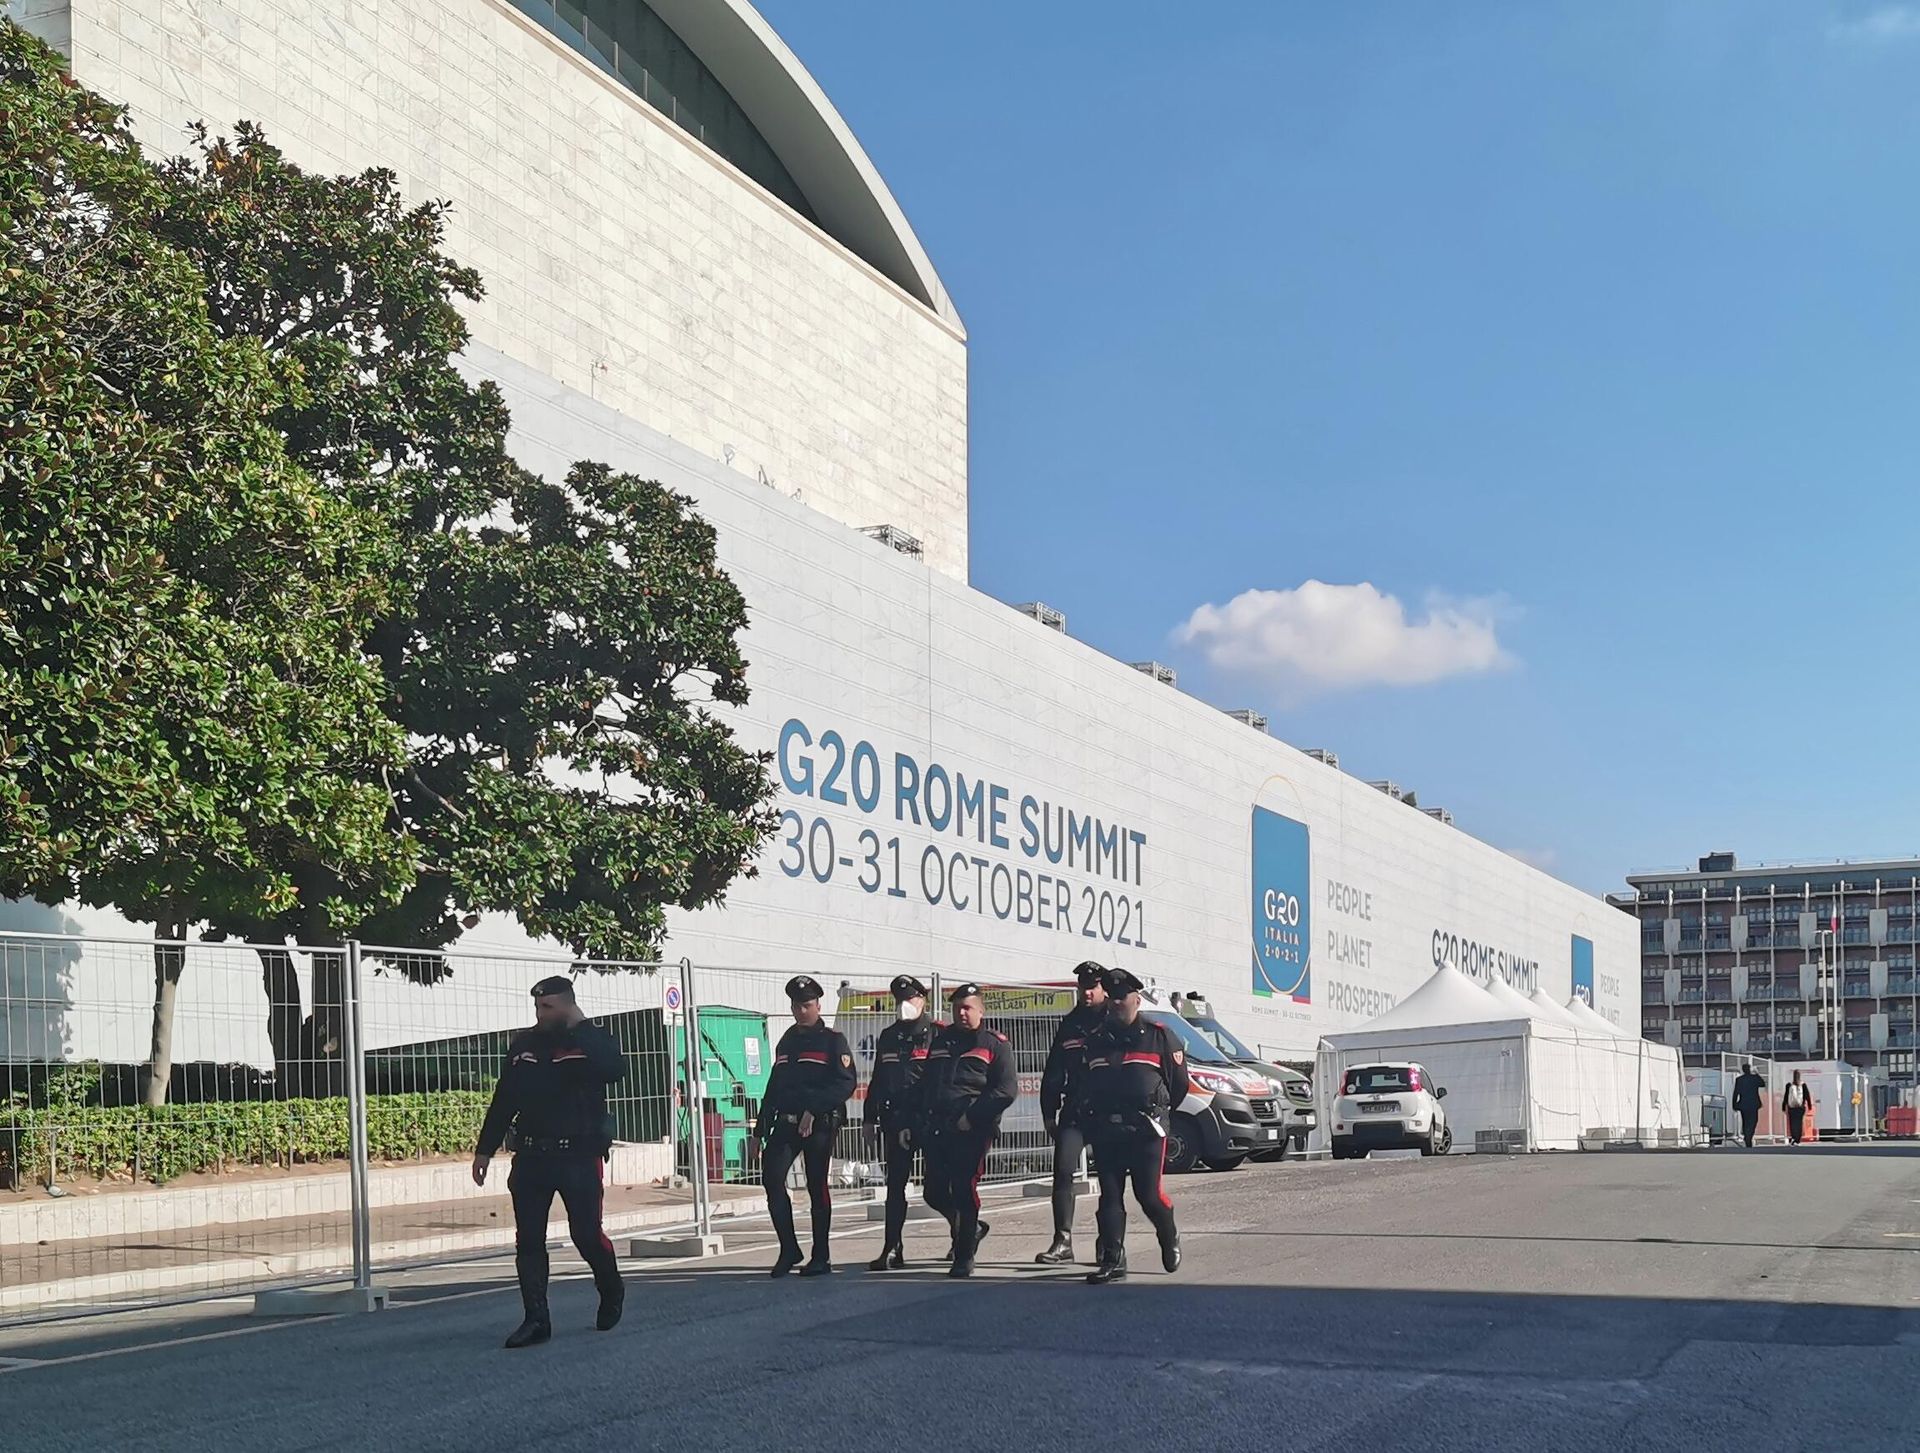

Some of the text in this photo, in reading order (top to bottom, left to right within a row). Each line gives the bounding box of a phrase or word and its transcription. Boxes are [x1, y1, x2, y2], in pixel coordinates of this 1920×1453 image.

[778, 717, 1147, 886] G20 ROME SUMMIT
[779, 809, 1148, 949] 30-31 OCTOBER 2021
[1264, 888, 1299, 927] G20
[1327, 879, 1372, 921] PEOPLE
[1264, 926, 1299, 945] ITALIA
[1327, 930, 1373, 969] PLANET
[1461, 938, 1495, 979] ROME
[1498, 950, 1539, 992] SUMMIT
[1327, 980, 1398, 1018] PROSPERITY
